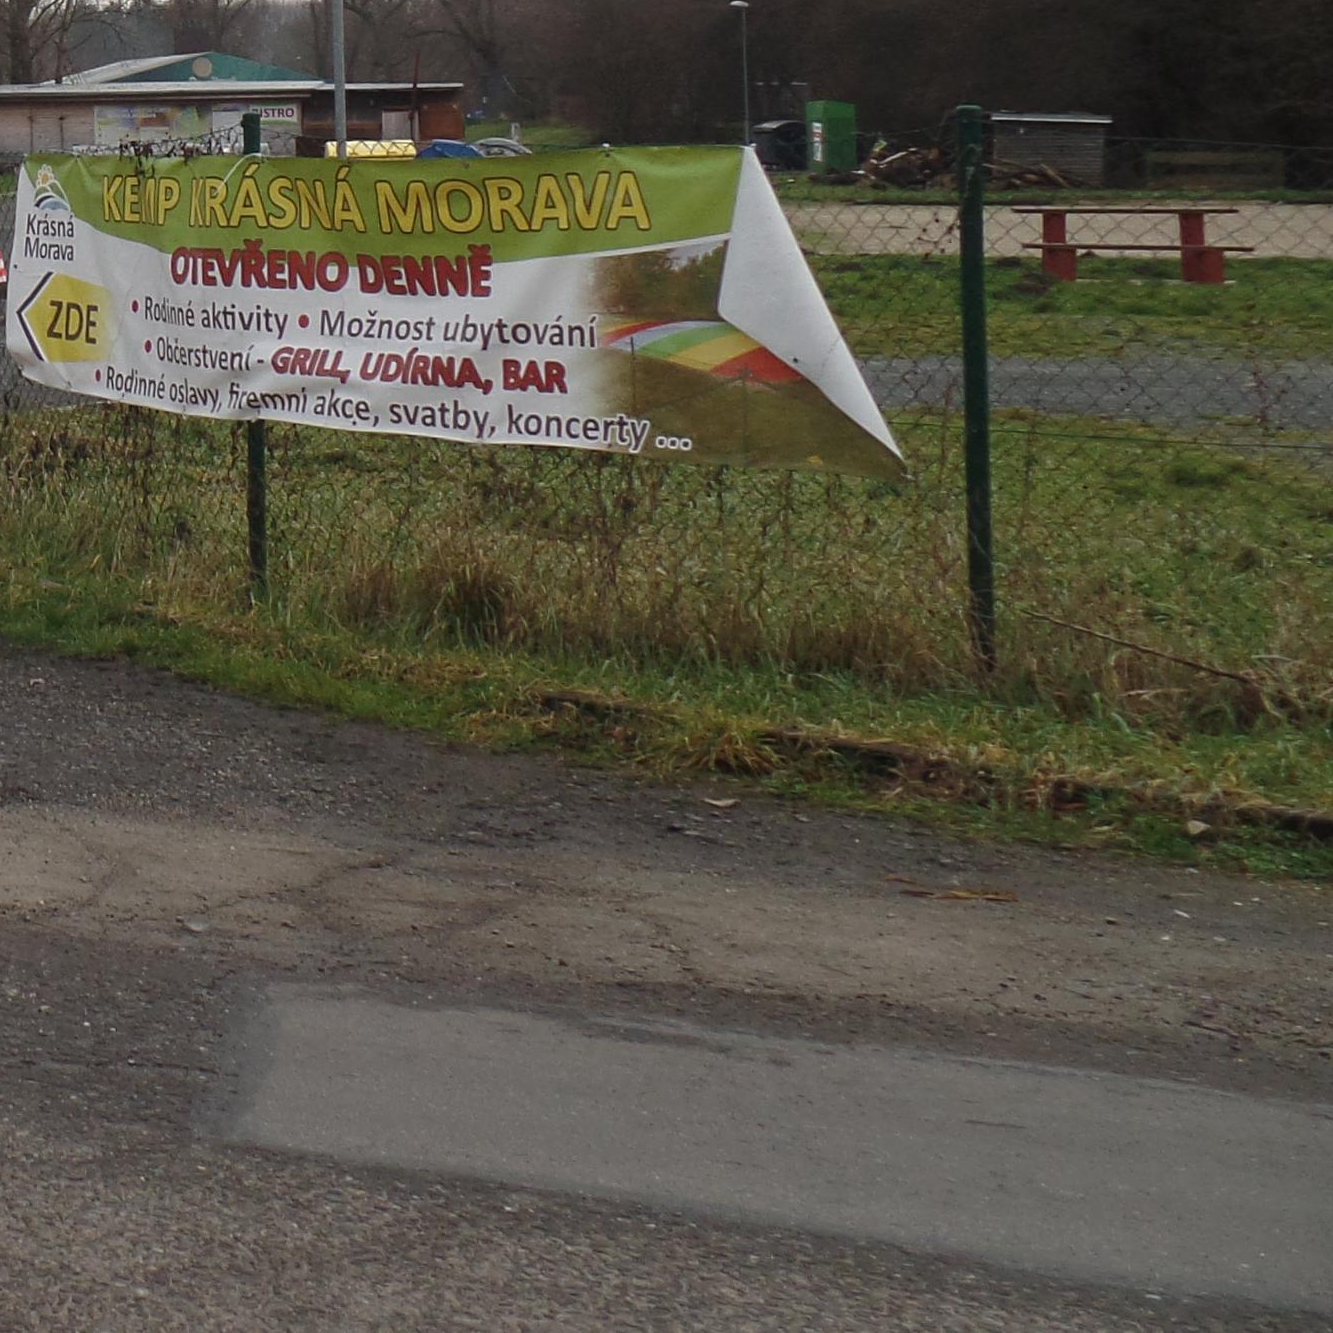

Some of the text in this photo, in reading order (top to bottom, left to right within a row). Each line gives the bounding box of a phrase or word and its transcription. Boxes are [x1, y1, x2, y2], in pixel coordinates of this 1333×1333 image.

[252, 108, 295, 118] ISTRO
[25, 212, 75, 238] Krásná
[103, 162, 651, 234] KEMP KRÁSNÁ MORAVA
[24, 236, 75, 262] Morava
[170, 239, 493, 297] OTEVŘENO DENNĚ
[46, 300, 99, 344] ZDE
[144, 296, 598, 351] Rodinné aktivity Možnost ubytování
[156, 336, 253, 372] Občerstvení
[271, 346, 351, 384] GRILL,
[359, 345, 493, 396] UDÍRNA,
[501, 358, 569, 394] BAR
[106, 368, 167, 402] Rodinné
[169, 376, 222, 413] oslavy,
[228, 383, 307, 415] firemní
[314, 388, 379, 426] akce,
[389, 398, 497, 438] svatby,
[507, 404, 650, 451] koncerty
